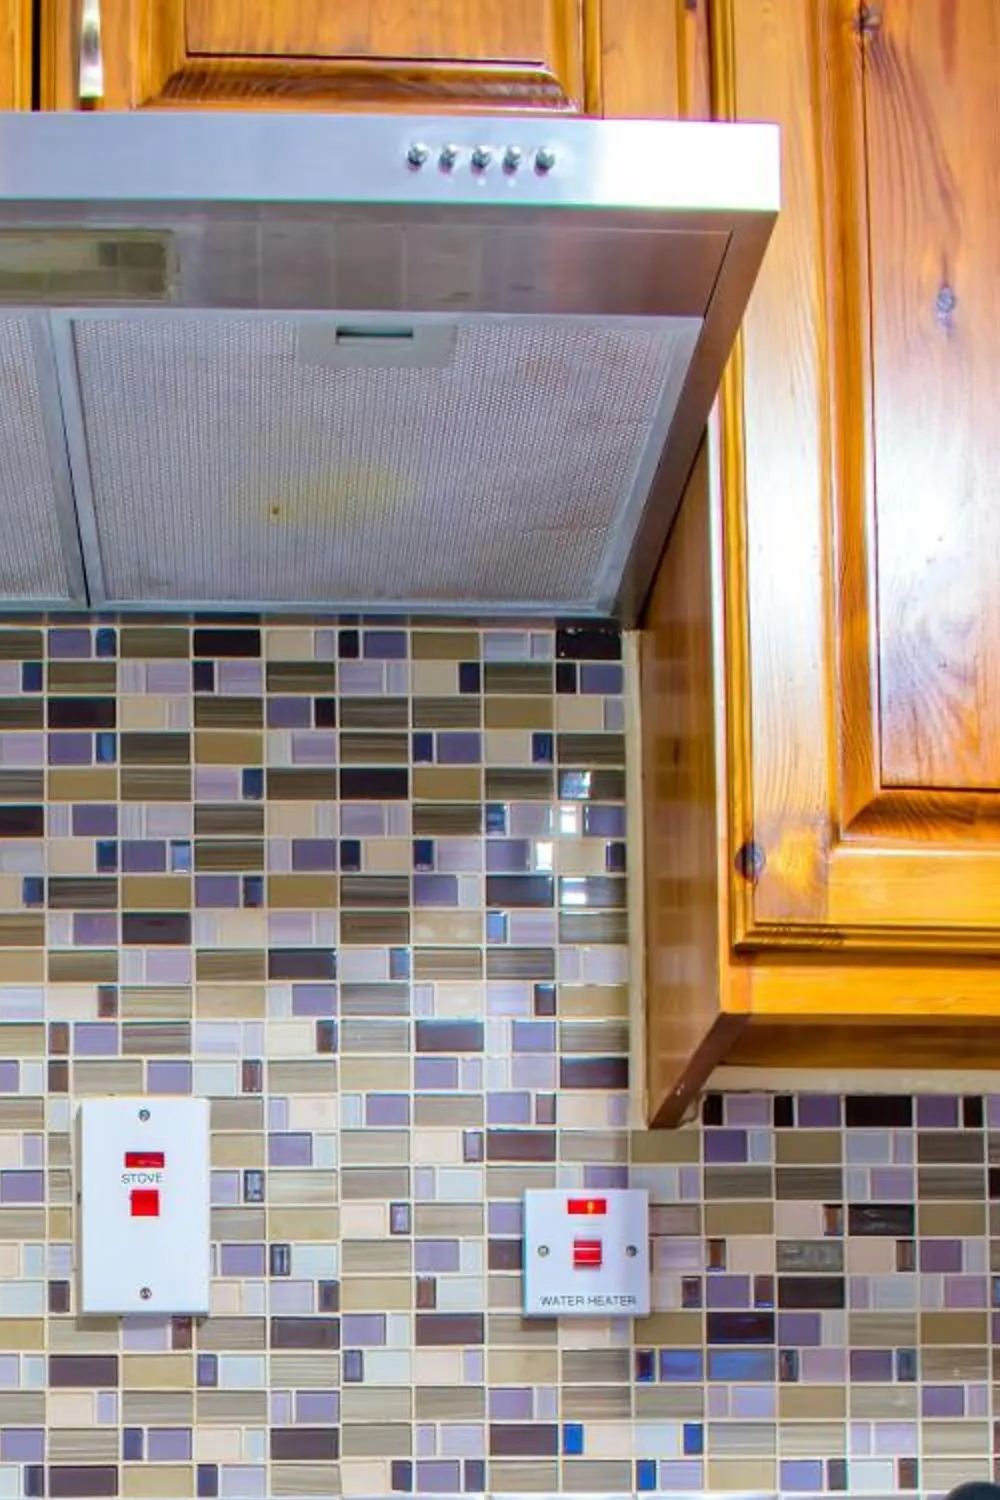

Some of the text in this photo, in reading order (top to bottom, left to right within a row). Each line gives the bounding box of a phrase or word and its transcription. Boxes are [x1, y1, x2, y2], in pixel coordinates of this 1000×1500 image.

[121, 1172, 163, 1184] STOVE
[540, 1295, 637, 1307] WATER HEATER
